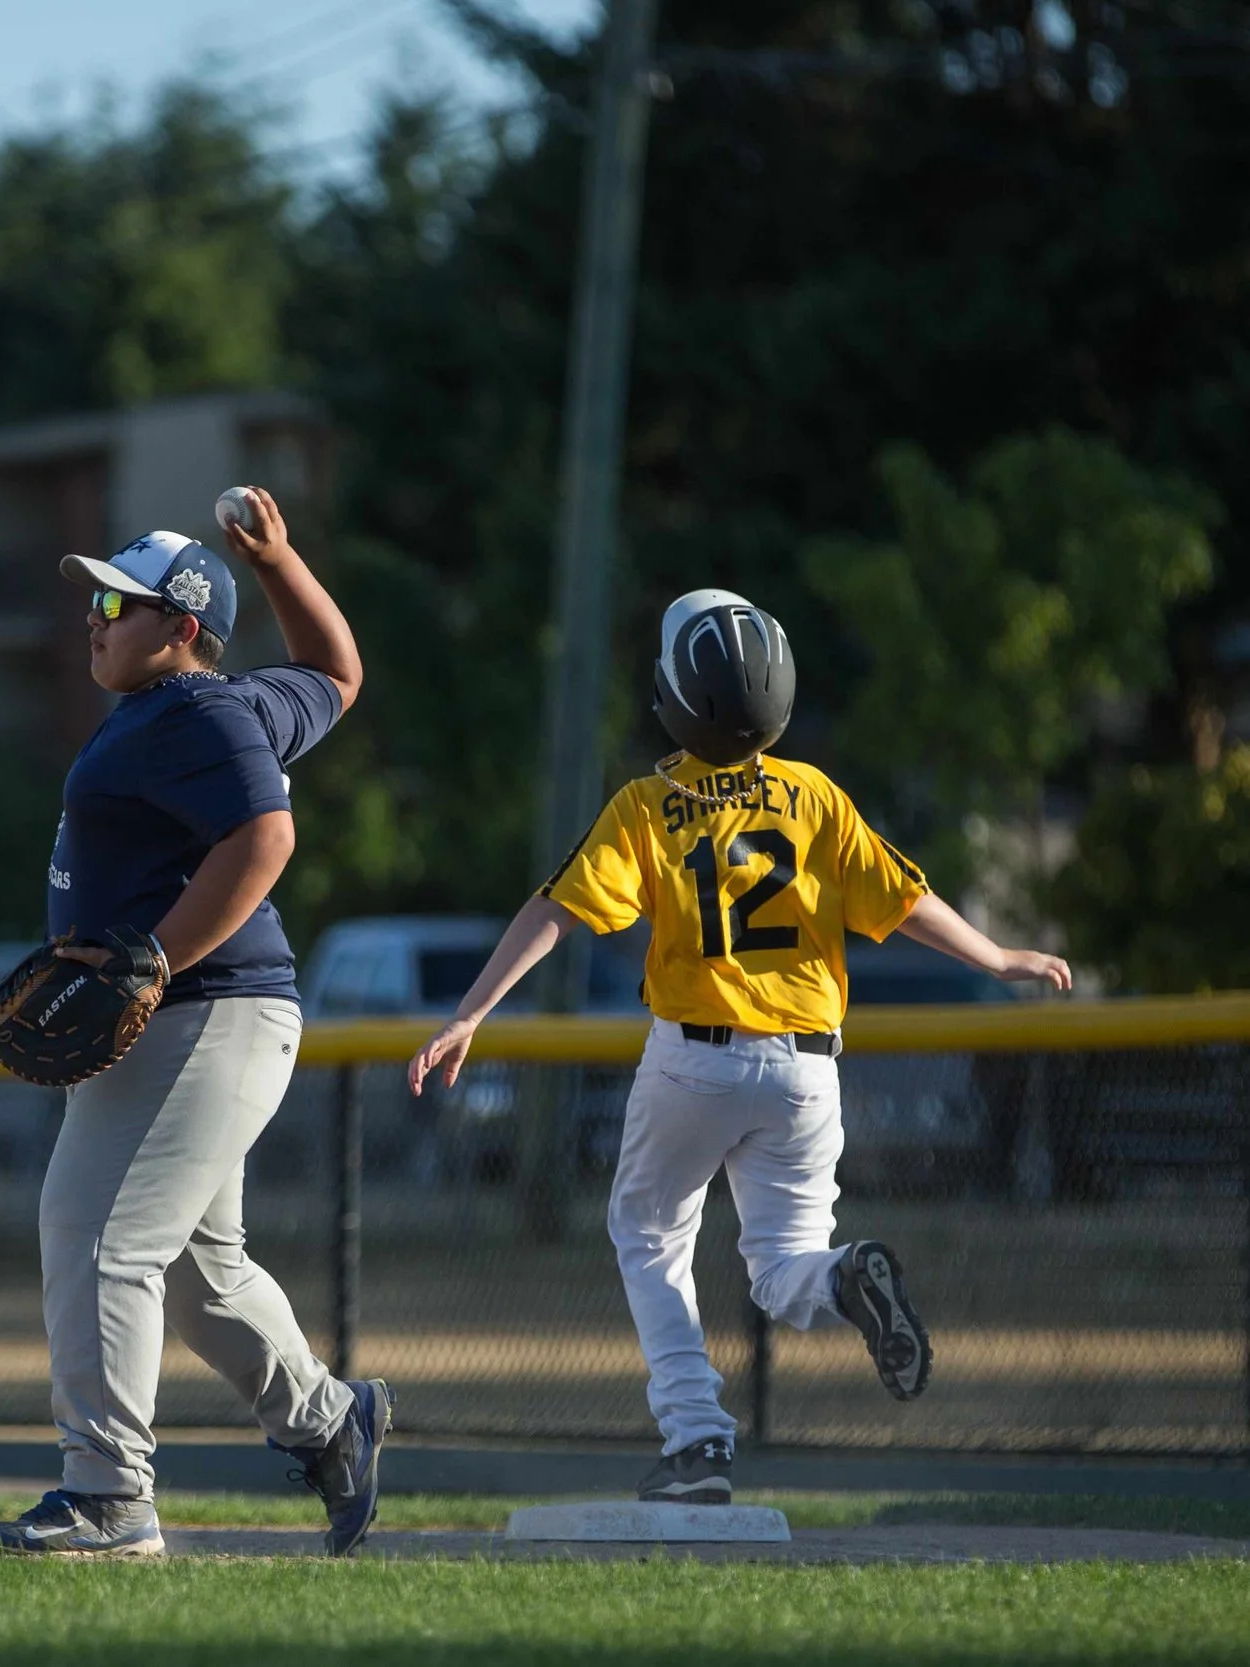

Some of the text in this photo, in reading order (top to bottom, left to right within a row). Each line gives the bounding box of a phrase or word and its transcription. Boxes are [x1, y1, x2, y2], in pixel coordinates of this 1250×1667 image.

[662, 769, 800, 834] SHIRLEY
[683, 829, 798, 958] 12
[38, 975, 85, 1027] EASTON
